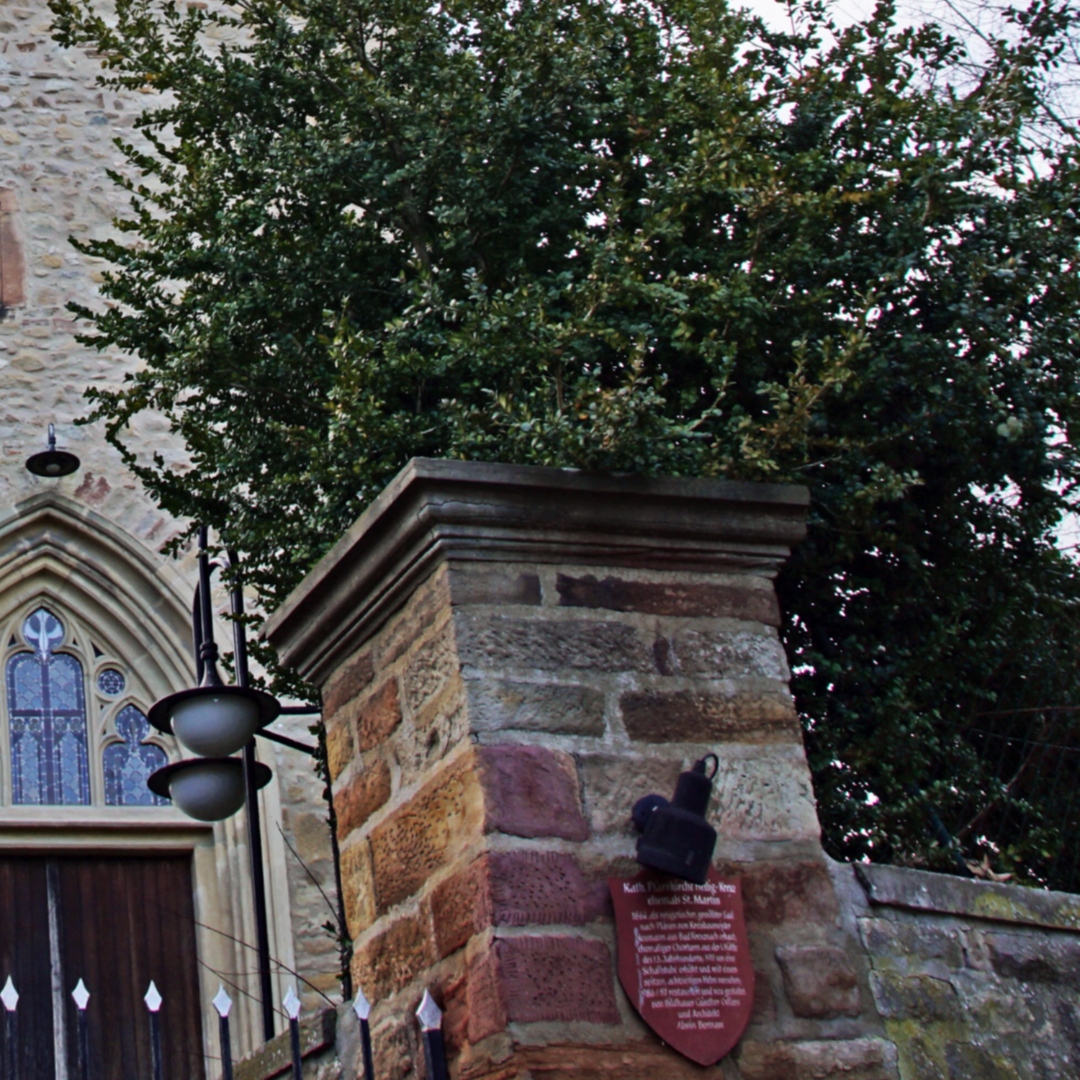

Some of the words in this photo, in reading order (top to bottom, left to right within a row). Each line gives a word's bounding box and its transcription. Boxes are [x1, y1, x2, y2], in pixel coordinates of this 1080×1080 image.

[647, 895, 680, 905] ehemals
[682, 895, 692, 904] St.
[693, 895, 721, 905] Martin
[699, 965, 711, 973] und
[701, 987, 712, 995] und
[677, 1010, 691, 1018] und
[692, 1009, 720, 1018] Architekt
